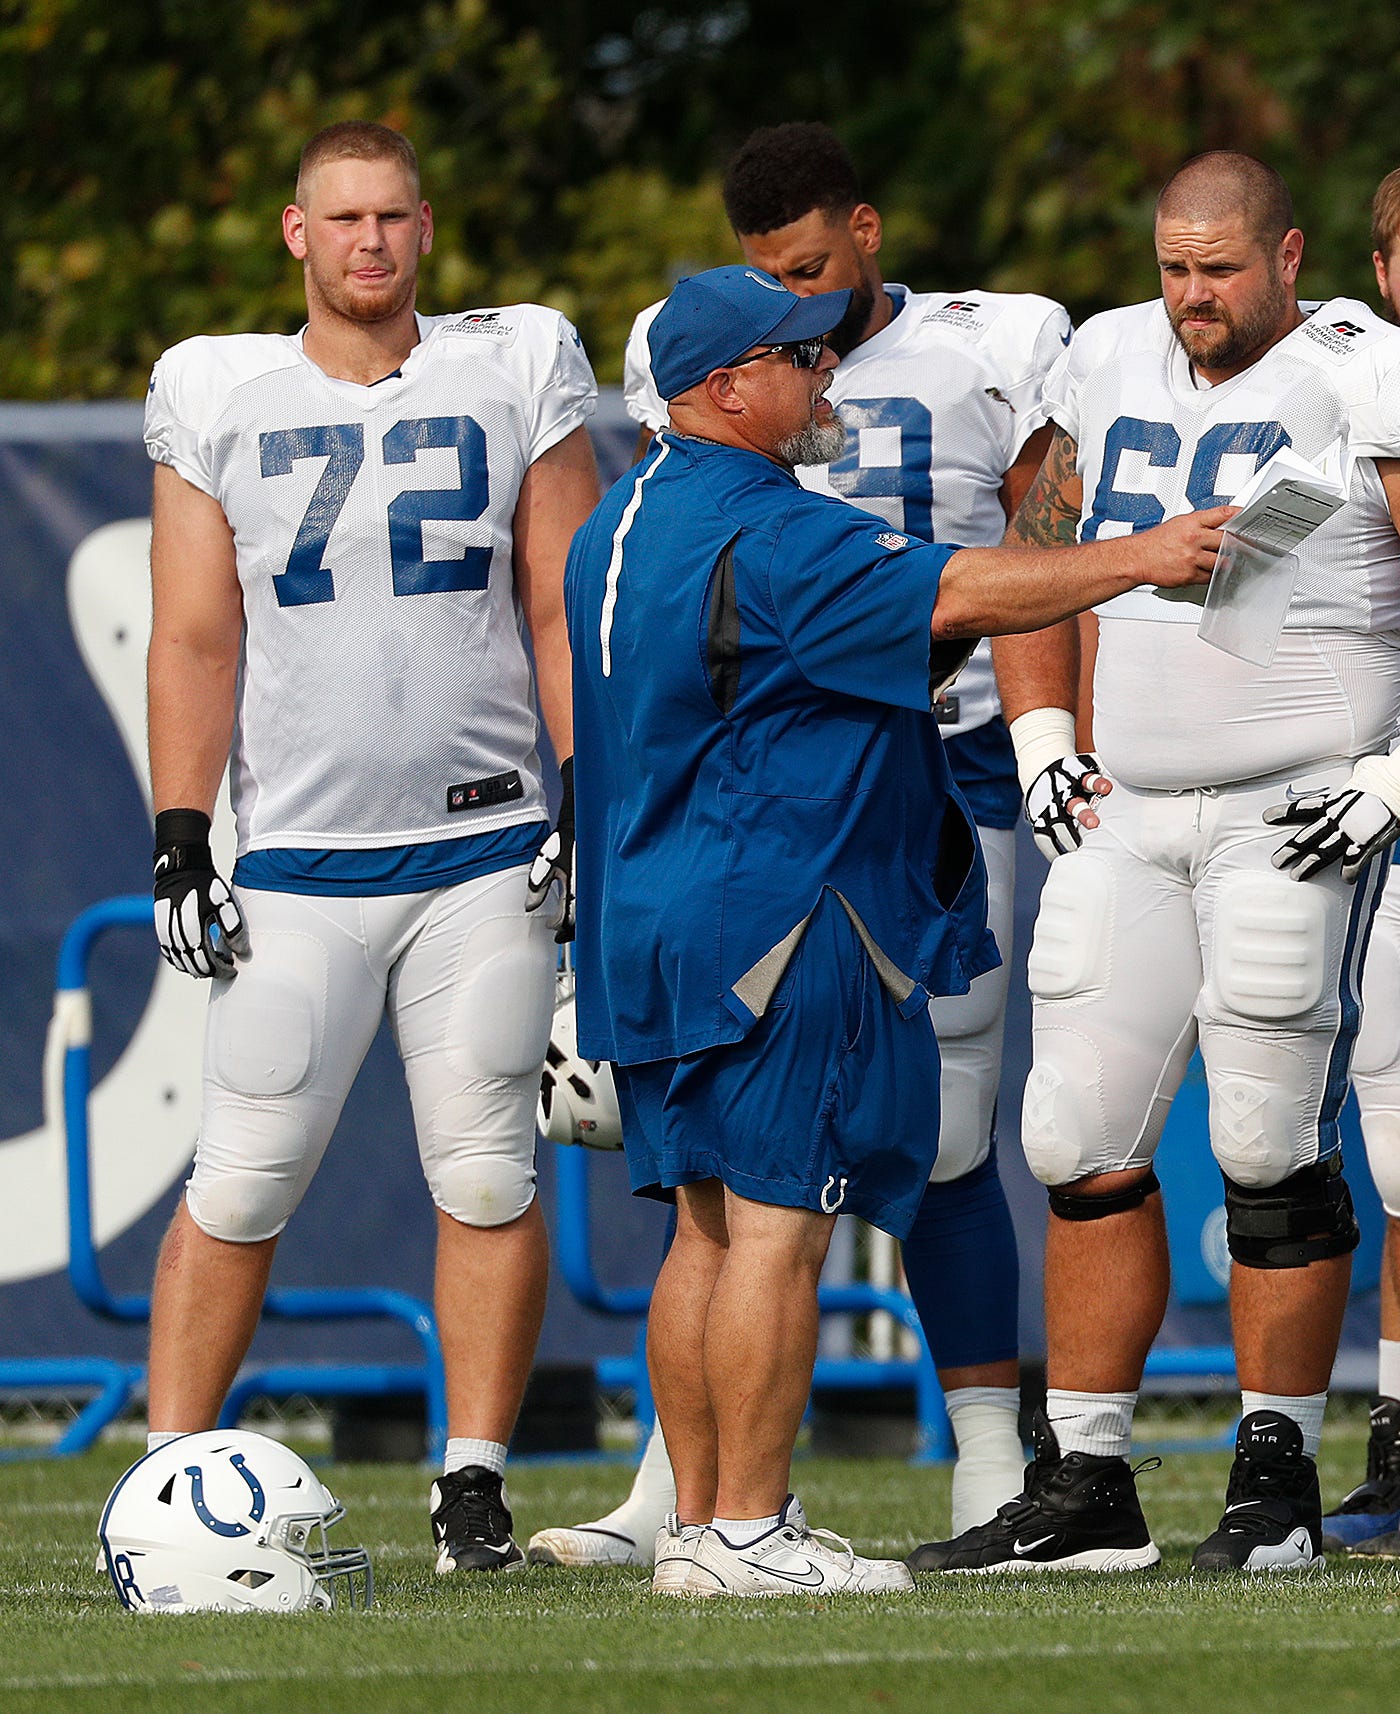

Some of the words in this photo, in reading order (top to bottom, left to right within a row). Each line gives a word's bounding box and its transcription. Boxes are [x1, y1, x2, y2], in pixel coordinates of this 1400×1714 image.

[259, 414, 494, 607] 72
[1251, 1434, 1278, 1444] AIR
[664, 1545, 687, 1555] AIR
